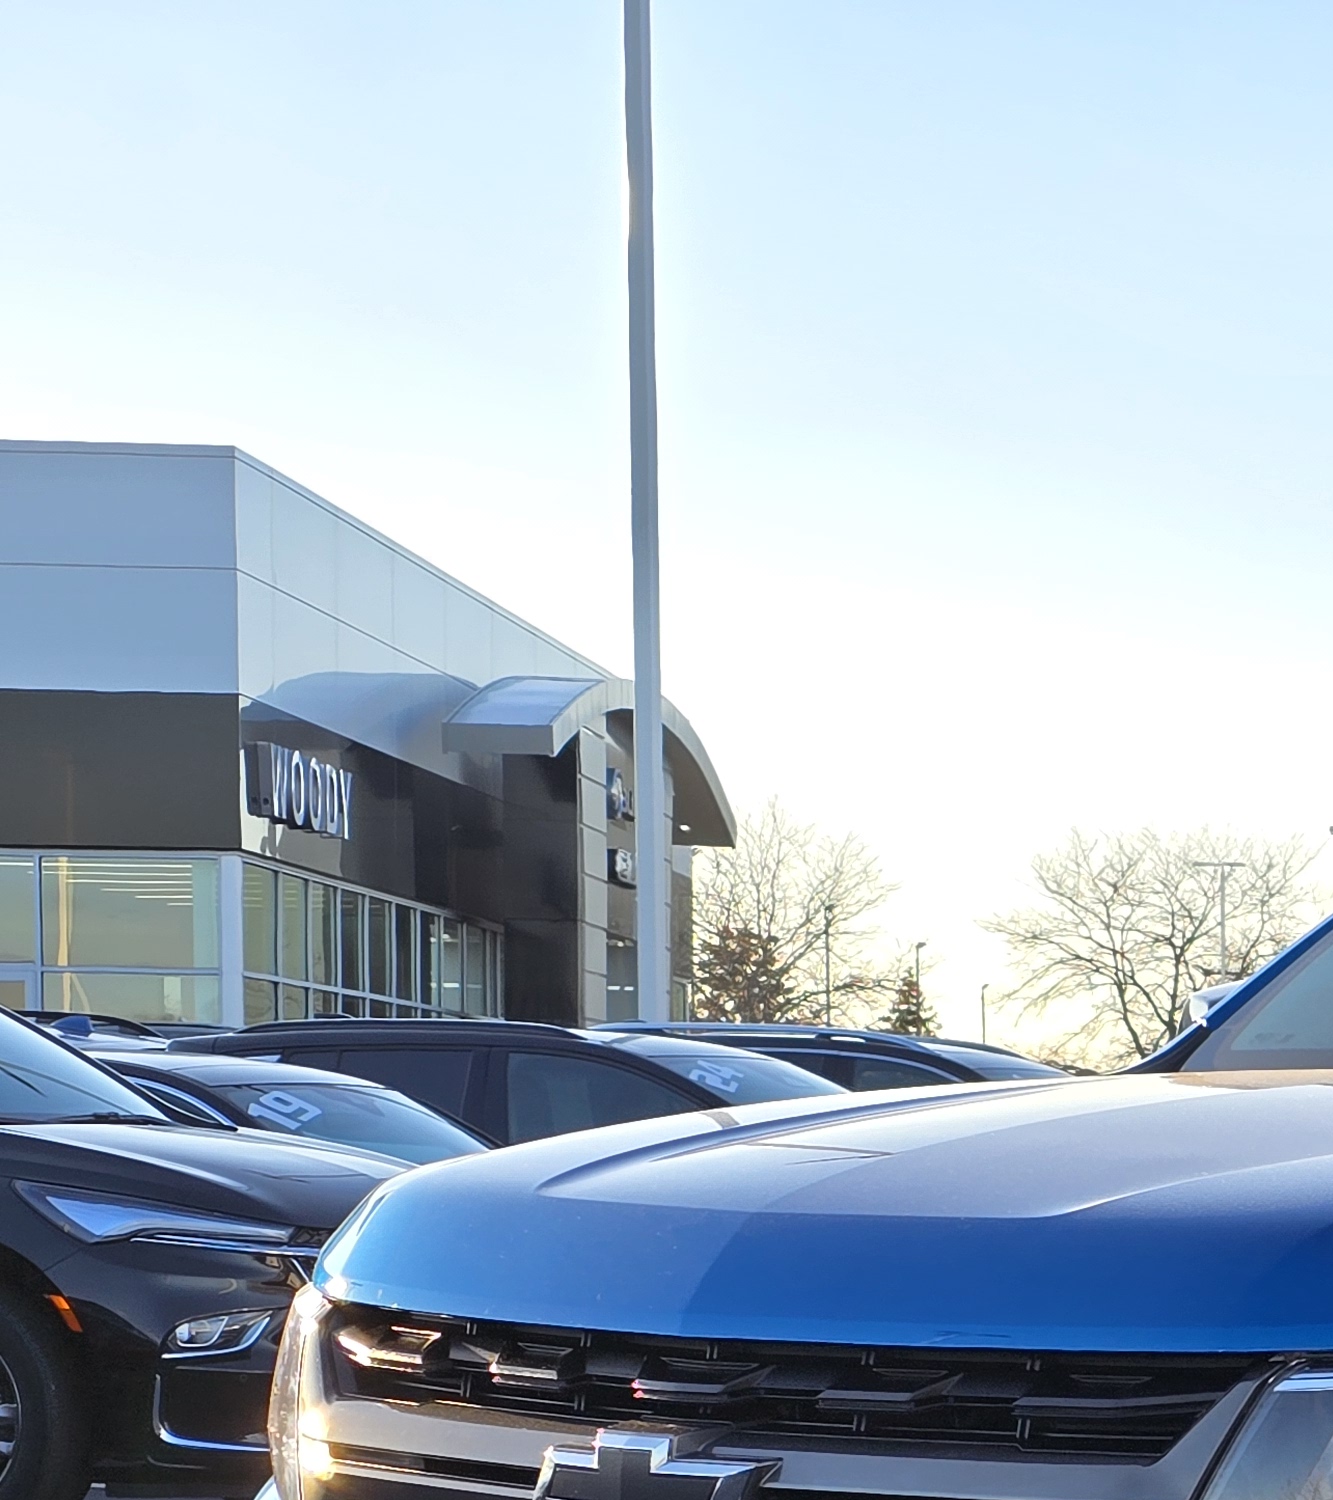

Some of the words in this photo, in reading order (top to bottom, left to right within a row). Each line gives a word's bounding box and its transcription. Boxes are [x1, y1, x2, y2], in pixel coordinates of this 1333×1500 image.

[270, 742, 353, 840] WOODY
[688, 1059, 744, 1094] 24
[248, 1090, 323, 1131] 19
